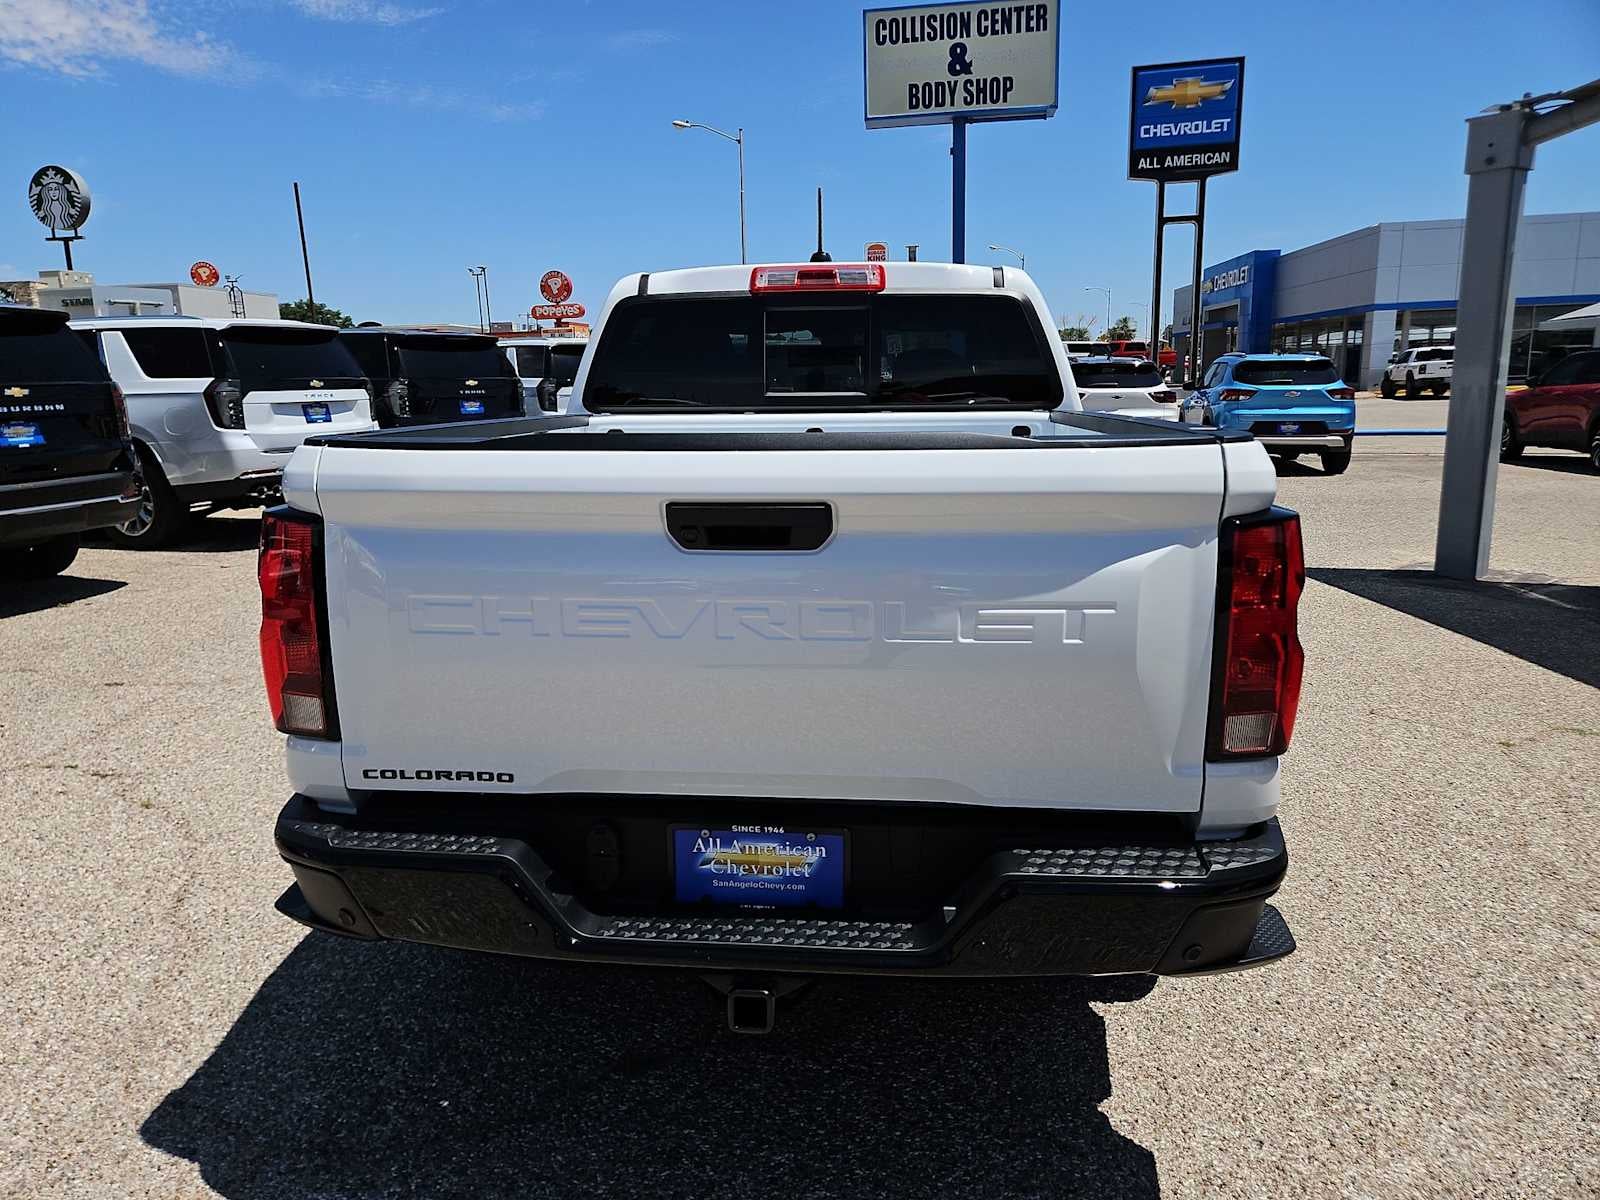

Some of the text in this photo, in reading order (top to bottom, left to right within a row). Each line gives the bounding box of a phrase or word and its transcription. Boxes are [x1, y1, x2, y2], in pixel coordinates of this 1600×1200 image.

[874, 3, 1049, 46] COLLISION CENTER
[947, 42, 973, 77] &
[908, 76, 1014, 110] BODY SHOP
[1139, 118, 1231, 138] CHEVROLET
[1138, 151, 1230, 170] ALL AMERICAN
[1213, 266, 1249, 291] CHEVROLET
[407, 594, 1118, 645] CHEVROLET
[362, 769, 515, 784] COLORADO
[731, 825, 785, 835] SINCE 1946
[692, 837, 827, 859] All American
[710, 858, 812, 878] Chevrolet
[712, 879, 806, 891] SanAngeloChevy.com
